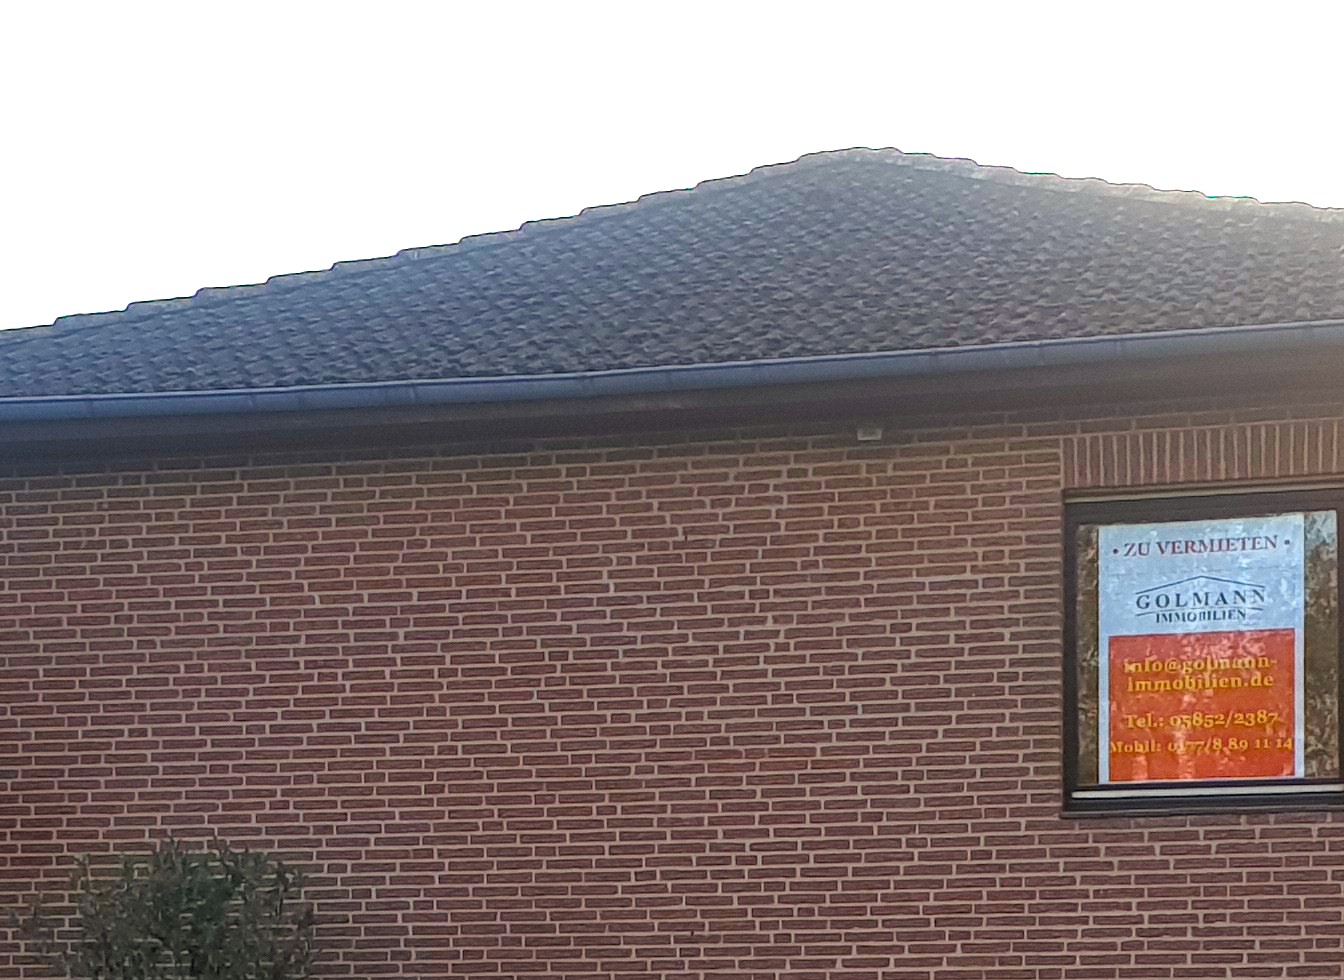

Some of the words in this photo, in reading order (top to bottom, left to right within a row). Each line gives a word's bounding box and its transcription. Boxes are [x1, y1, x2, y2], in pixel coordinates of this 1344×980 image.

[1123, 542, 1151, 557] ZU
[1156, 535, 1278, 556] VERMIETEN
[1136, 589, 1266, 609] GOLMANN
[1155, 608, 1247, 624] IMMOBILIEN
[1127, 672, 1274, 692] immobilien.de
[1124, 712, 1164, 728] Tel.:
